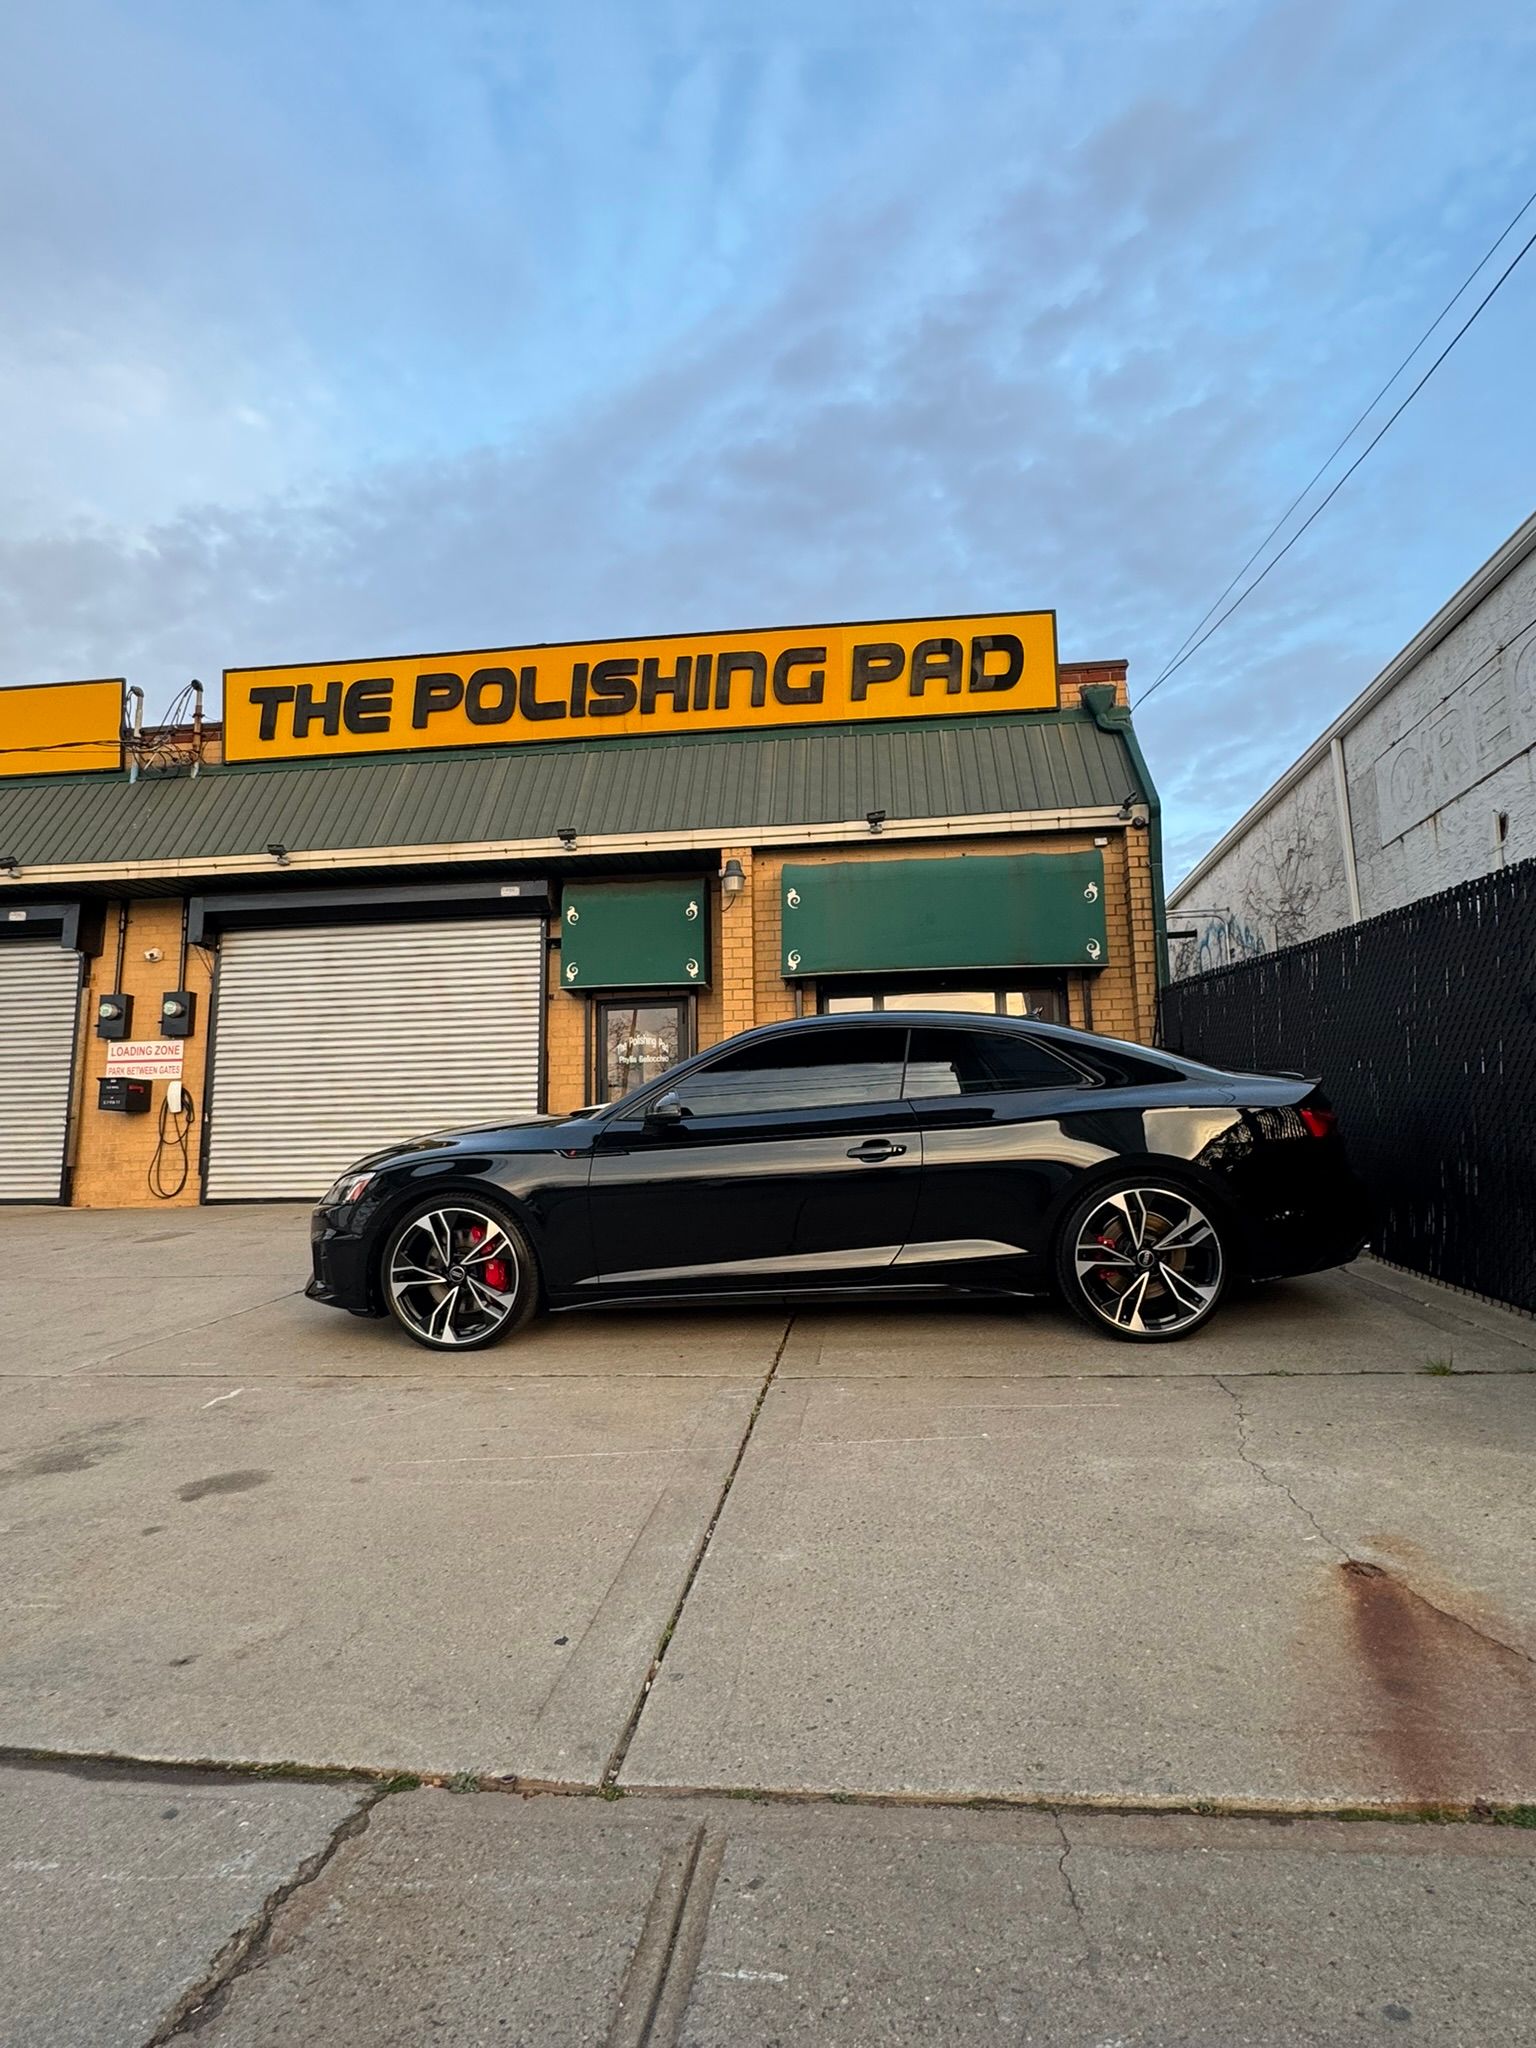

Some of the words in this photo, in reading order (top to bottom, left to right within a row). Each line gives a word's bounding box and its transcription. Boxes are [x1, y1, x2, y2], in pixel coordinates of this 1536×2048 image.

[249, 677, 395, 741] THE
[411, 645, 828, 729] POLISHING
[850, 633, 1025, 702] PAD
[111, 1045, 153, 1057] LOADING
[154, 1045, 181, 1056] ZONE
[107, 1066, 125, 1076] PARK
[126, 1065, 158, 1076] BETWEEN
[159, 1064, 181, 1075] GATES
